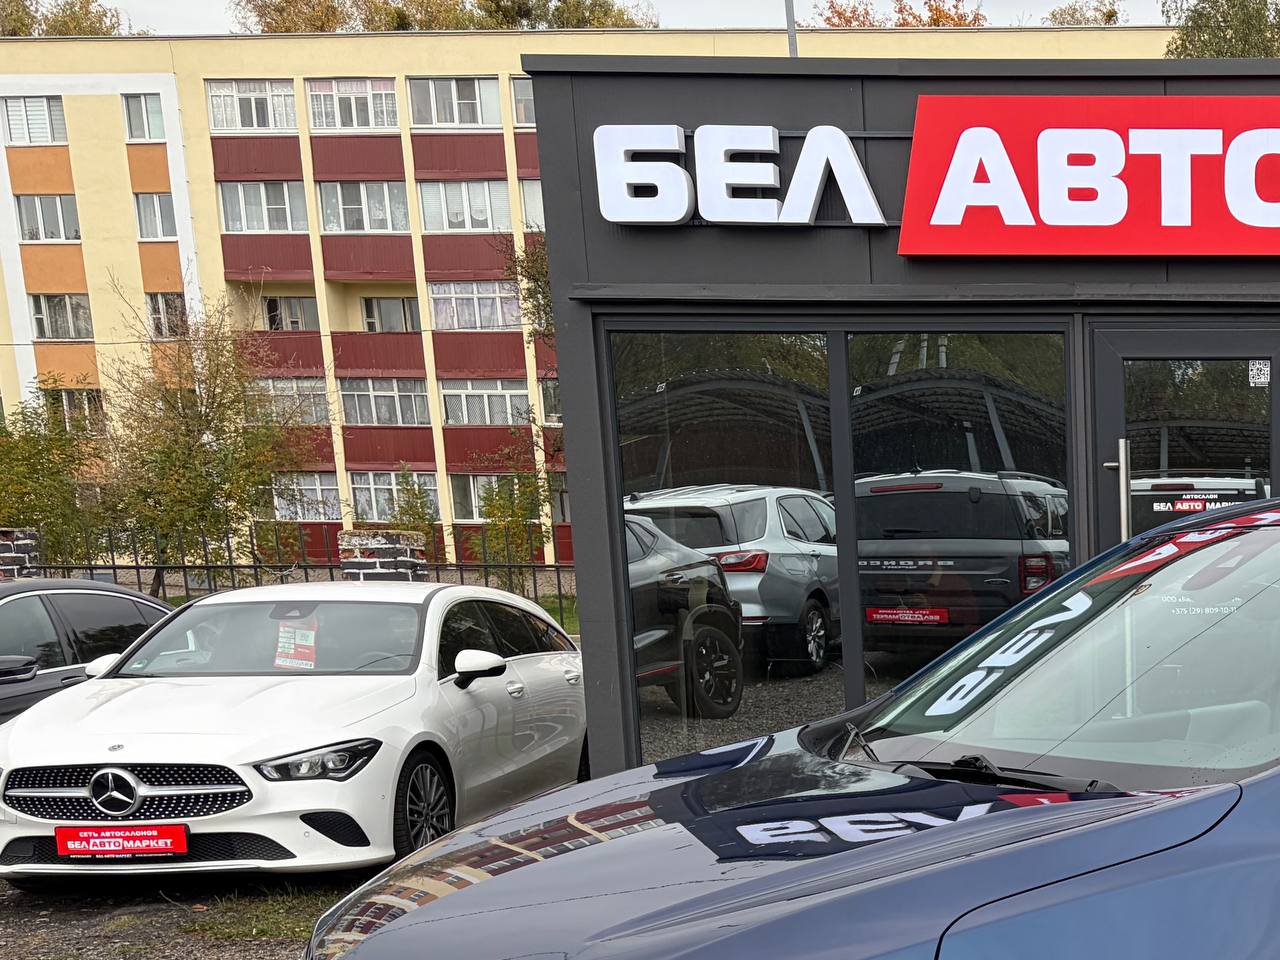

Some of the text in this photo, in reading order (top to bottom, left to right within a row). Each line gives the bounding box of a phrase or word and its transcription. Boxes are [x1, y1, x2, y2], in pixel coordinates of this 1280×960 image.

[593, 124, 888, 226] БЕЛ
[1153, 501, 1244, 512] БЕЛ АВТО МАР
[1189, 607, 1203, 615] (29)
[67, 839, 173, 849] БЕЛ АВТО МАРКЕТ
